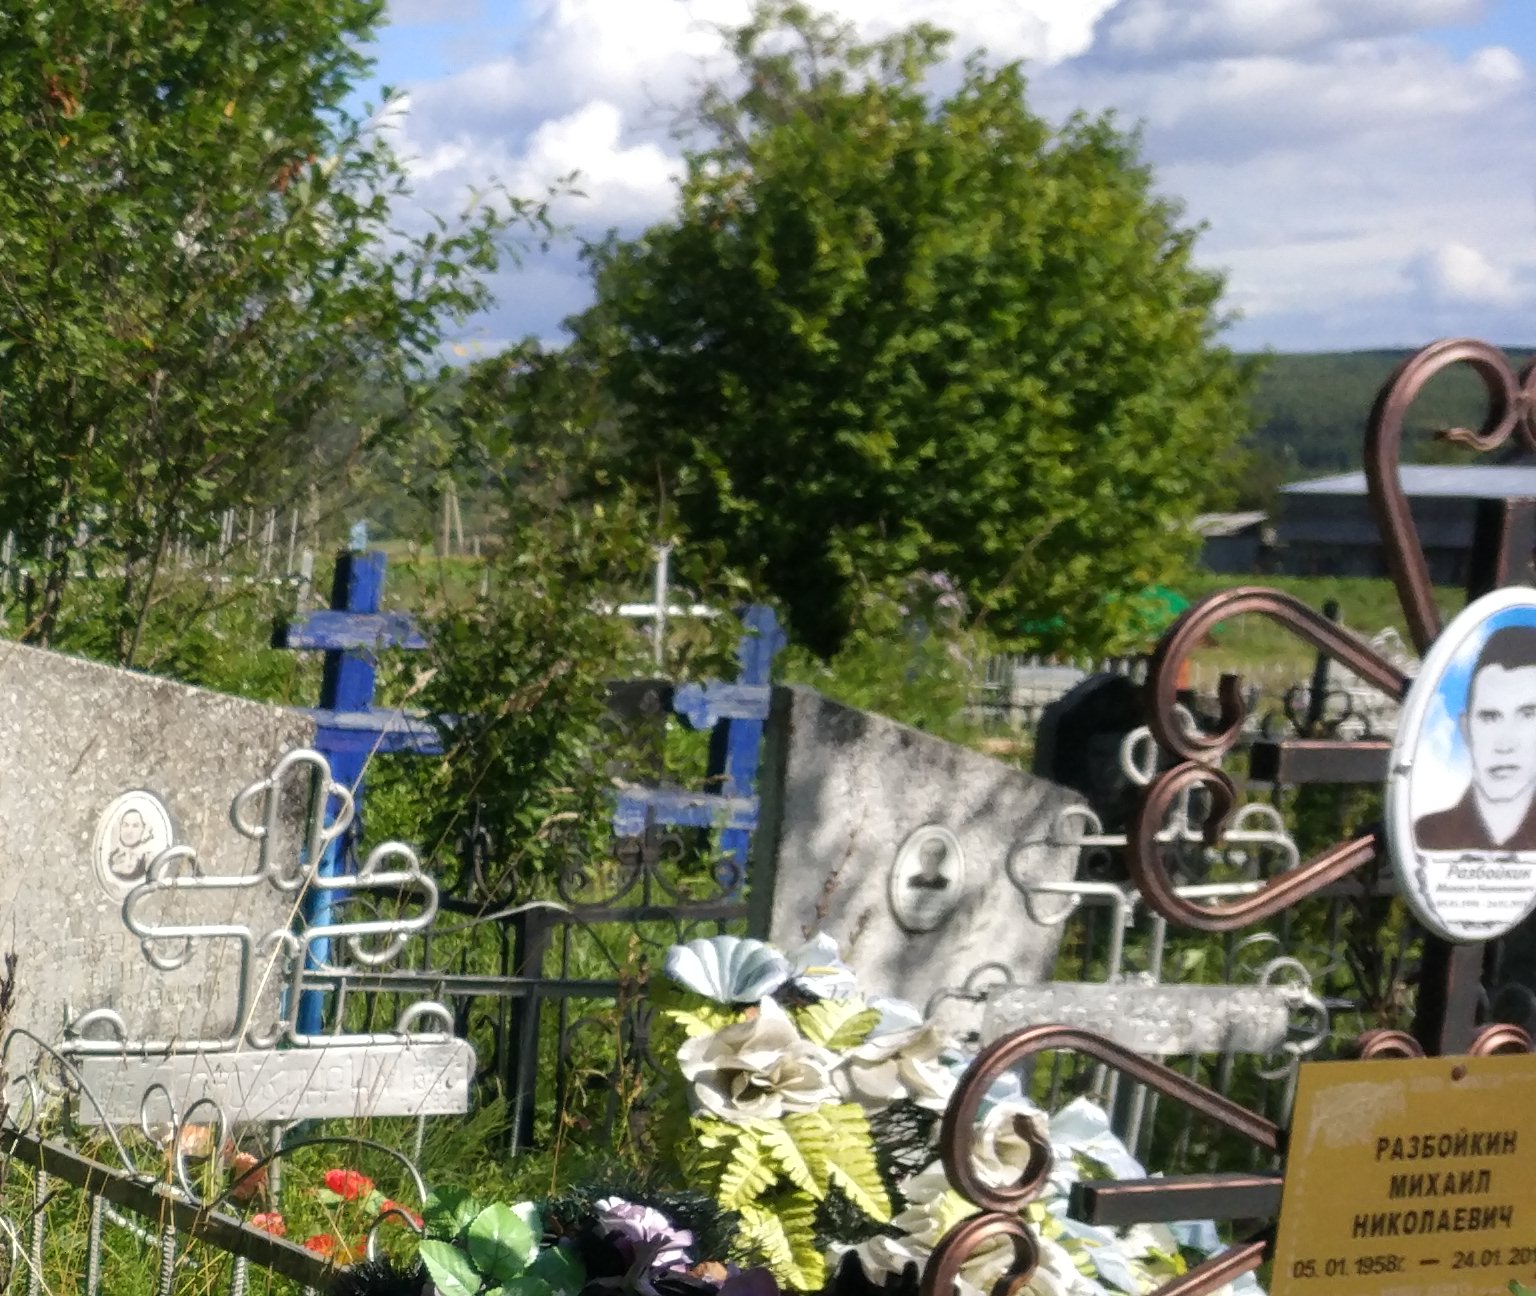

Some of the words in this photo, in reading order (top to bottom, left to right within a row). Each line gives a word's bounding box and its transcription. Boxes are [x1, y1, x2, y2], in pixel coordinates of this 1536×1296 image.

[1375, 1127, 1519, 1160] РАЗБОЙКИН
[1389, 1169, 1492, 1199] МИХАИЛ
[1352, 1206, 1514, 1239] НИКОЛАЕВИЧ
